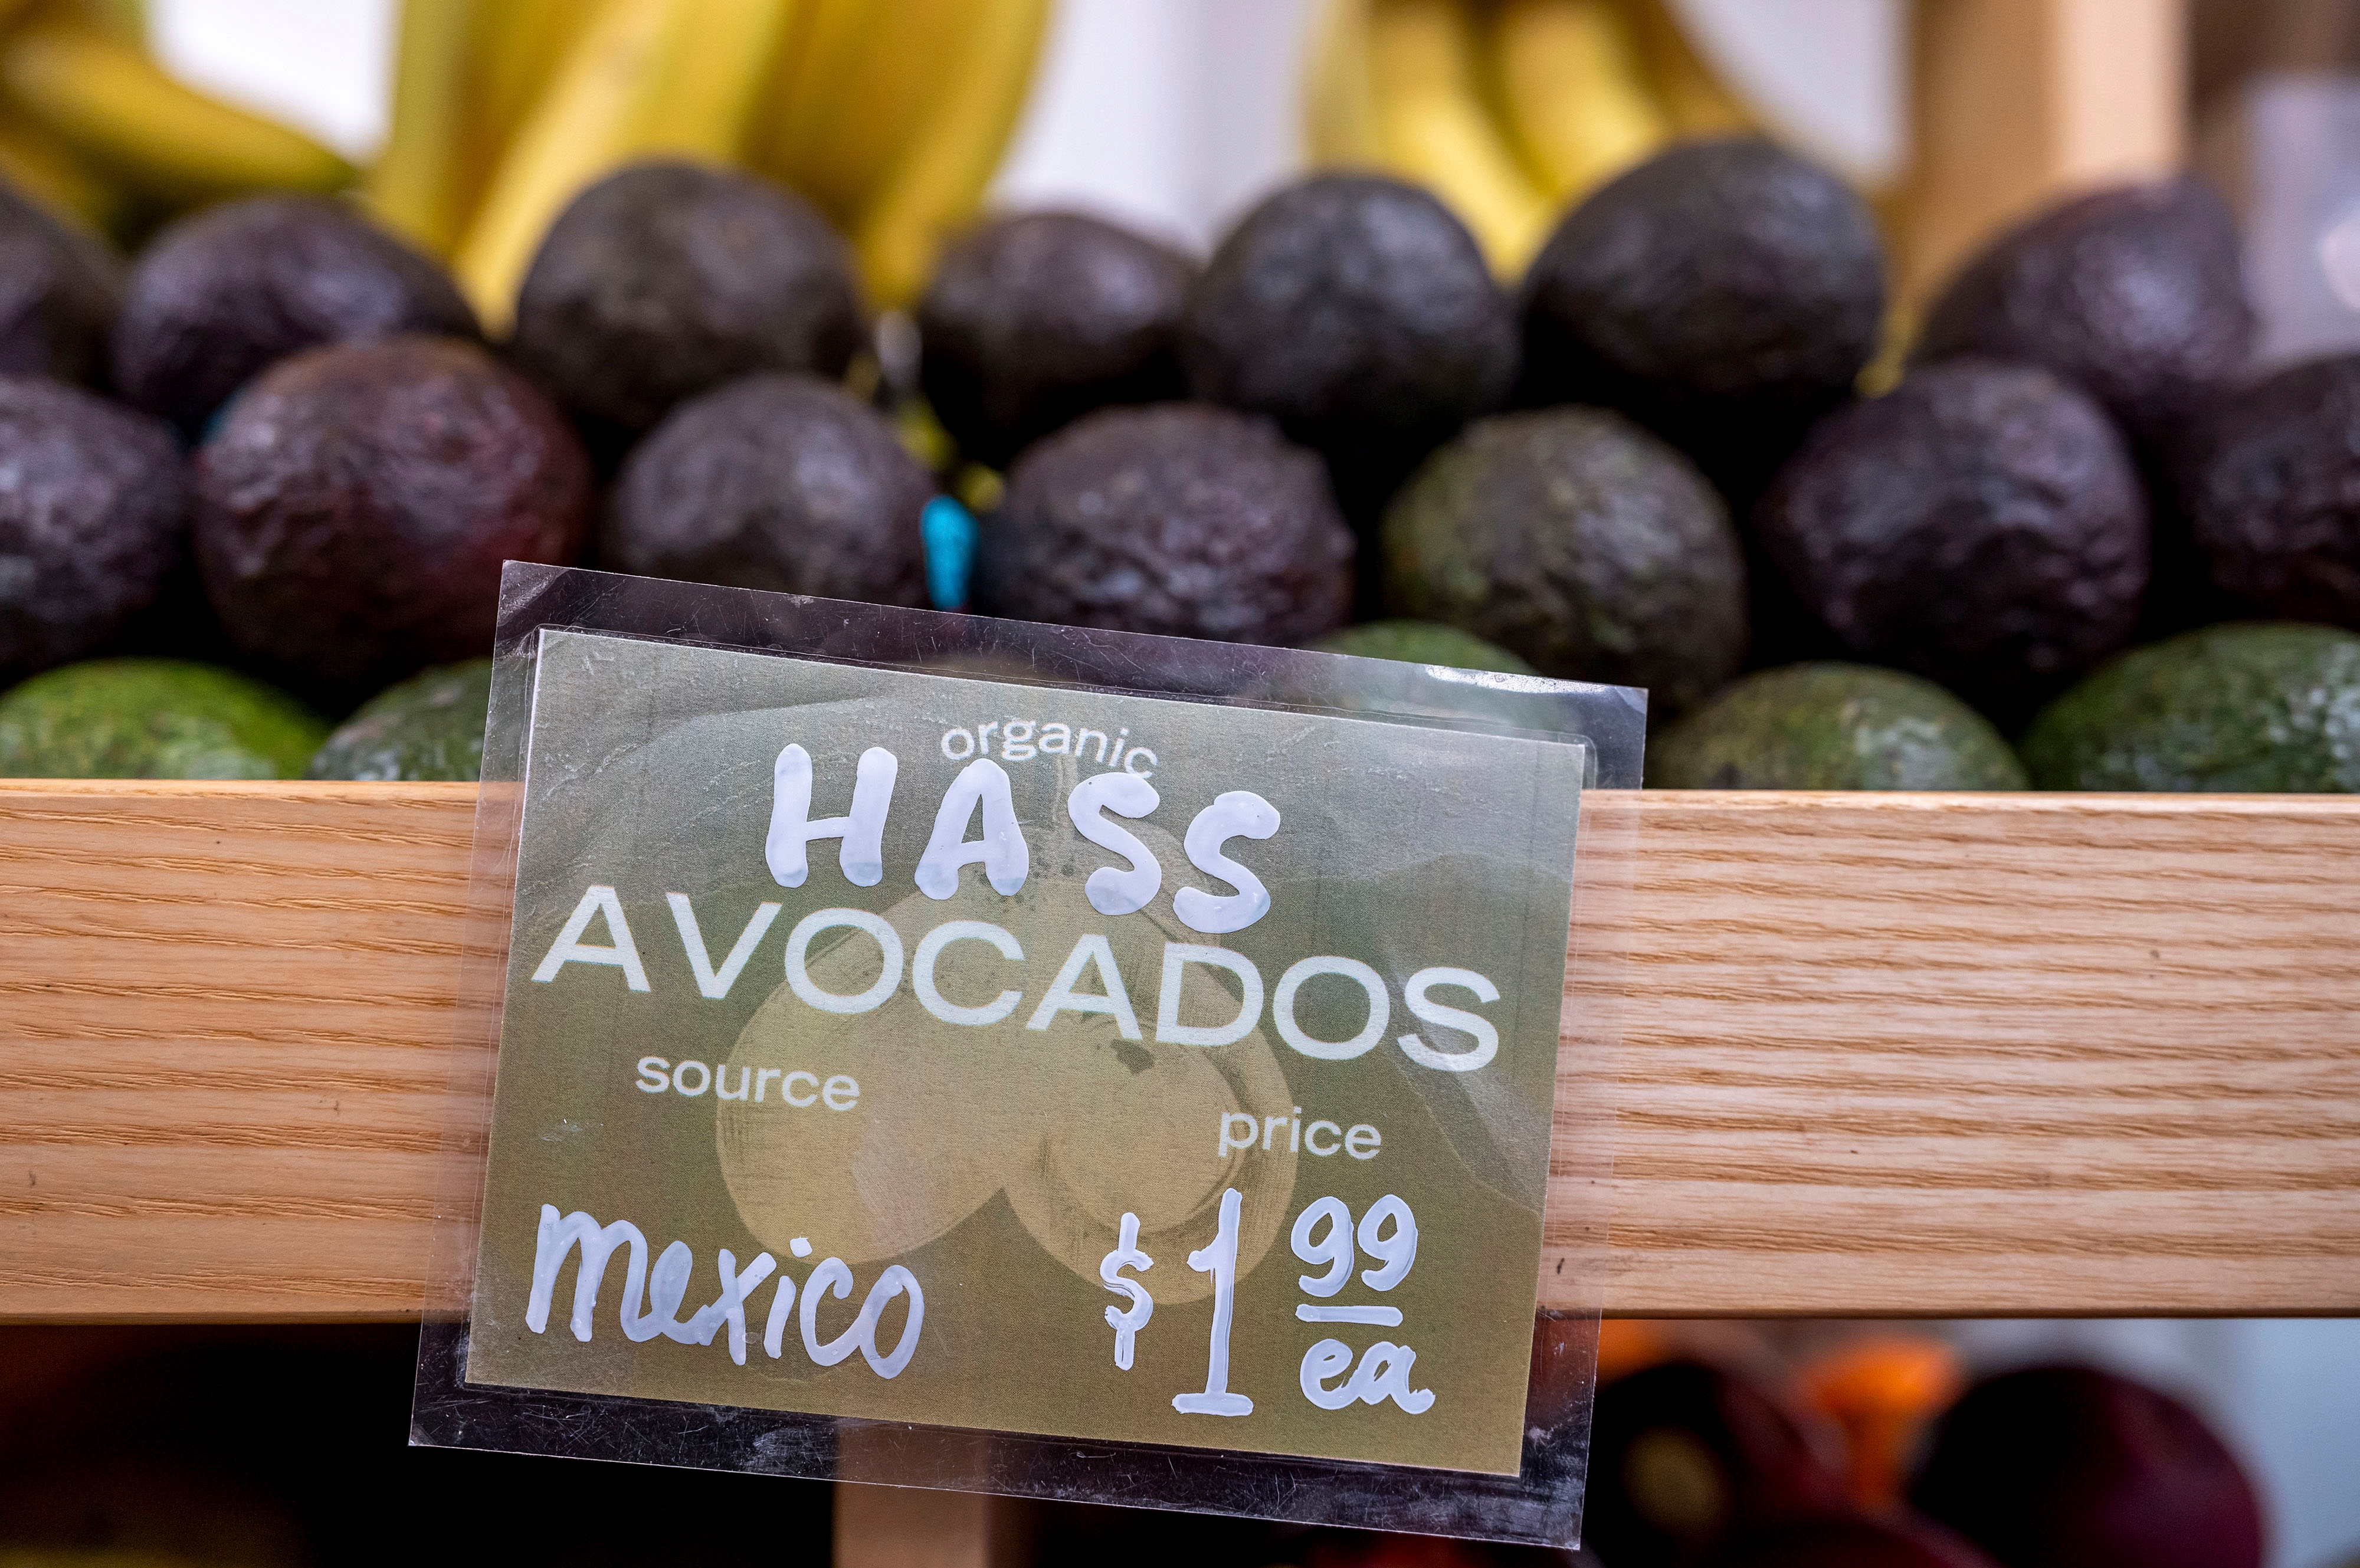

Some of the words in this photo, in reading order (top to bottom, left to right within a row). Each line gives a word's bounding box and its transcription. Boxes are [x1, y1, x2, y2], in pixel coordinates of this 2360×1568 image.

[941, 717, 1158, 779] organic
[765, 743, 1280, 934] HASS
[531, 884, 1500, 1072] AVOCADOS
[635, 1056, 860, 1111] source
[1217, 1107, 1382, 1160] price
[1299, 1339, 1436, 1415] ea
